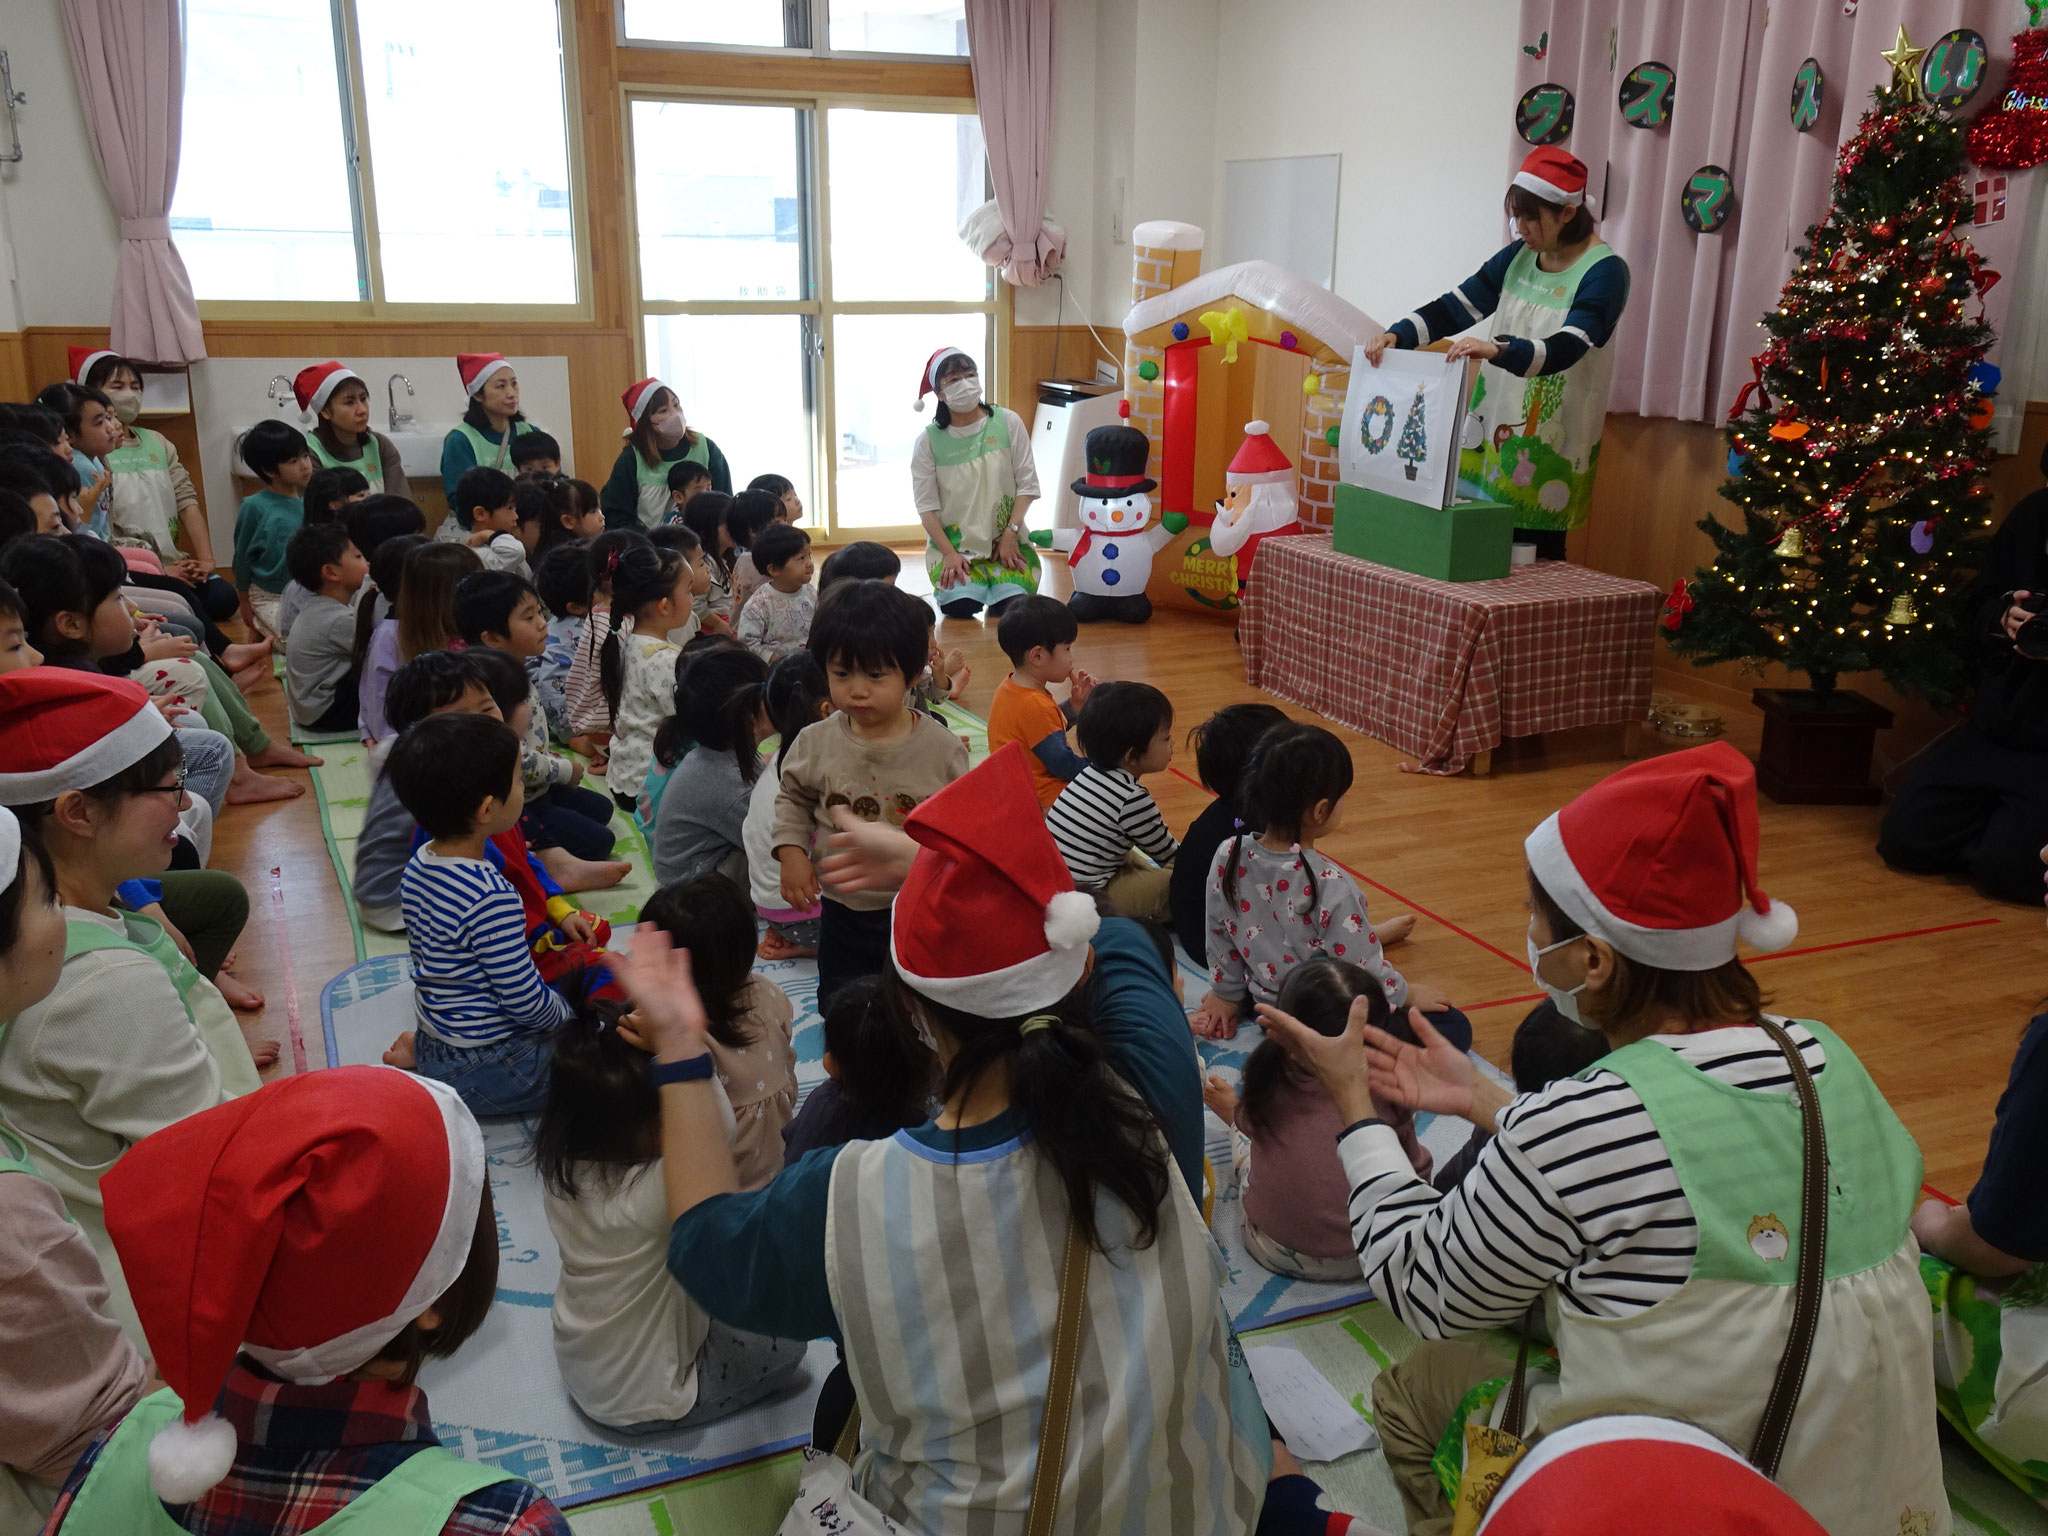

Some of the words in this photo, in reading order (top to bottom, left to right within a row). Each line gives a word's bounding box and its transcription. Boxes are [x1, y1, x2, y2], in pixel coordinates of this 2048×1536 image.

[1525, 89, 1567, 140] ク
[1623, 65, 1673, 126] ス
[1690, 173, 1728, 228] マ
[1793, 62, 1817, 129] ス
[1927, 42, 1982, 98] い
[1183, 556, 1233, 576] MERR
